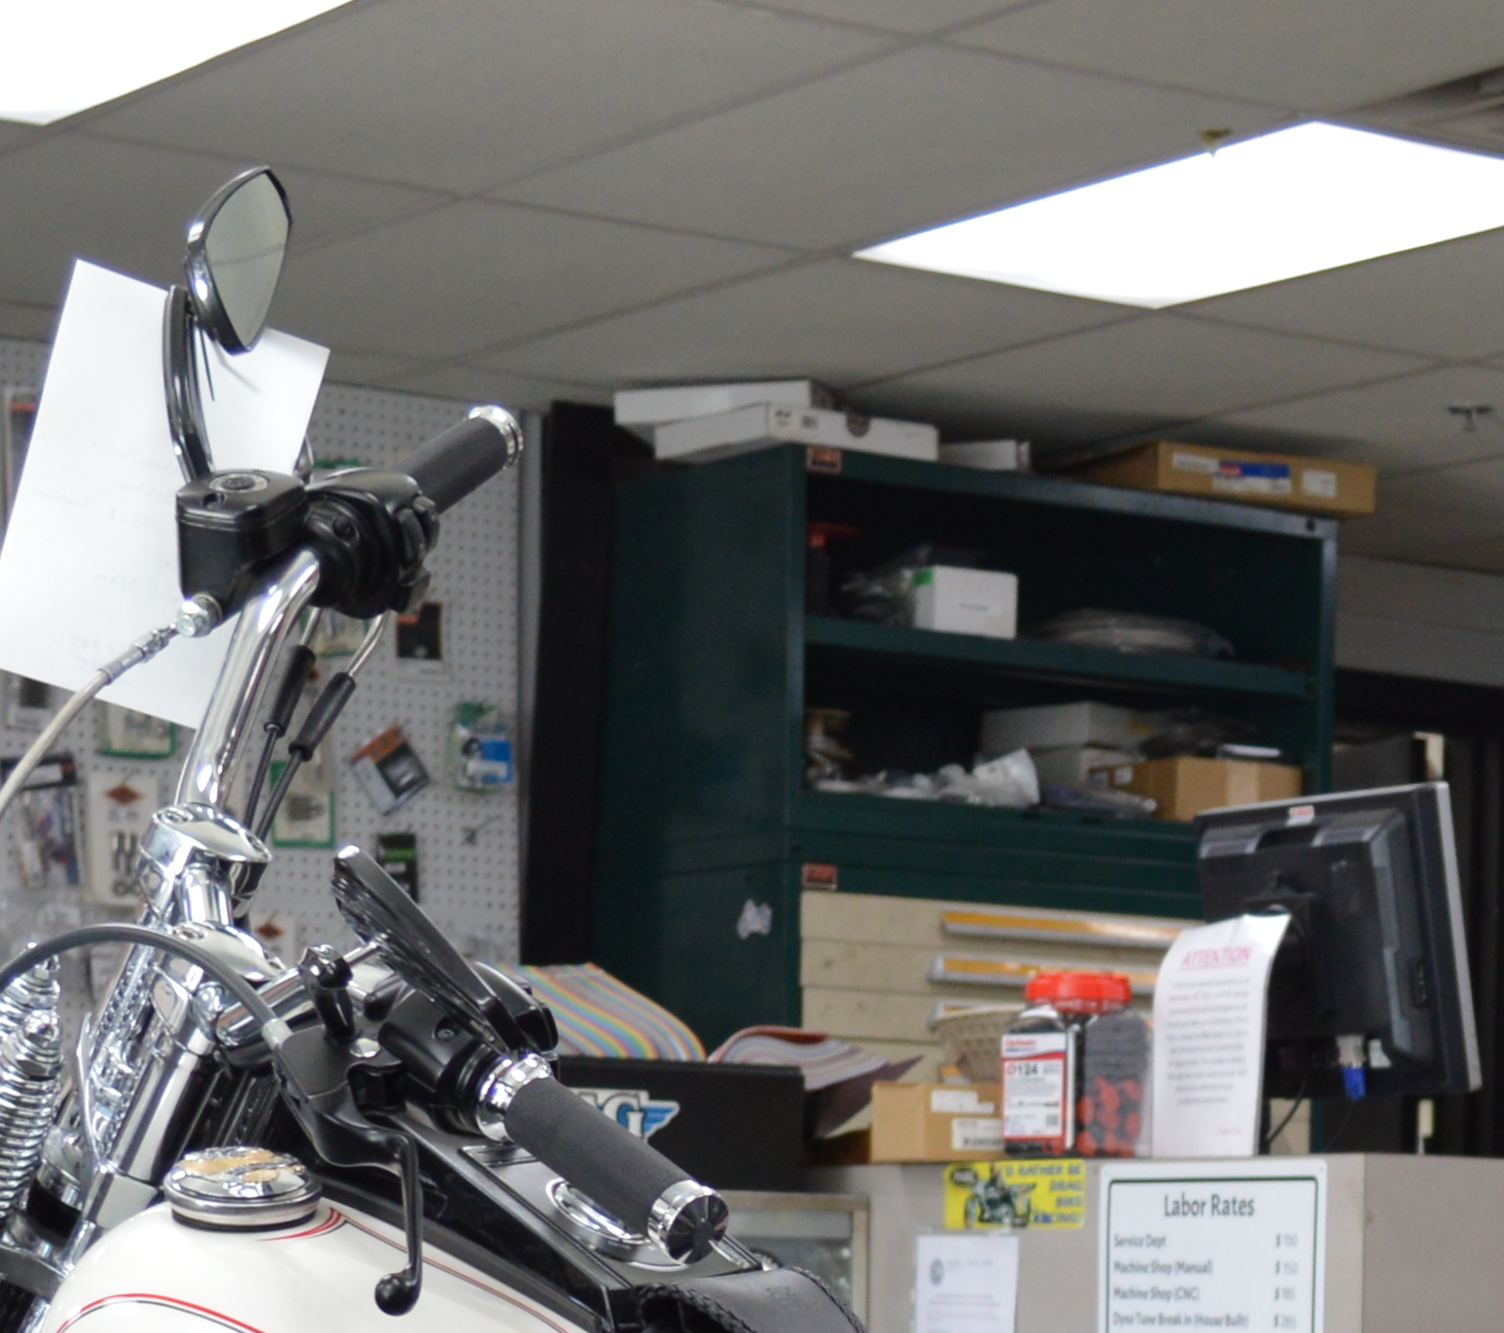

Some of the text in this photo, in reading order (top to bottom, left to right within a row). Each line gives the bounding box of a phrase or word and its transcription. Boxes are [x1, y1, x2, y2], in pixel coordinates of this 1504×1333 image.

[1182, 947, 1253, 968] ATTENTION
[1164, 1192, 1255, 1217] Labor Rates
[1113, 1234, 1168, 1250] Service Dept
[1113, 1260, 1148, 1275] Machine
[1150, 1260, 1173, 1276] Shop
[1113, 1286, 1148, 1300] Machine
[1150, 1286, 1173, 1302] Shop
[1135, 1312, 1156, 1325] Tune
[1158, 1312, 1182, 1326] Break
